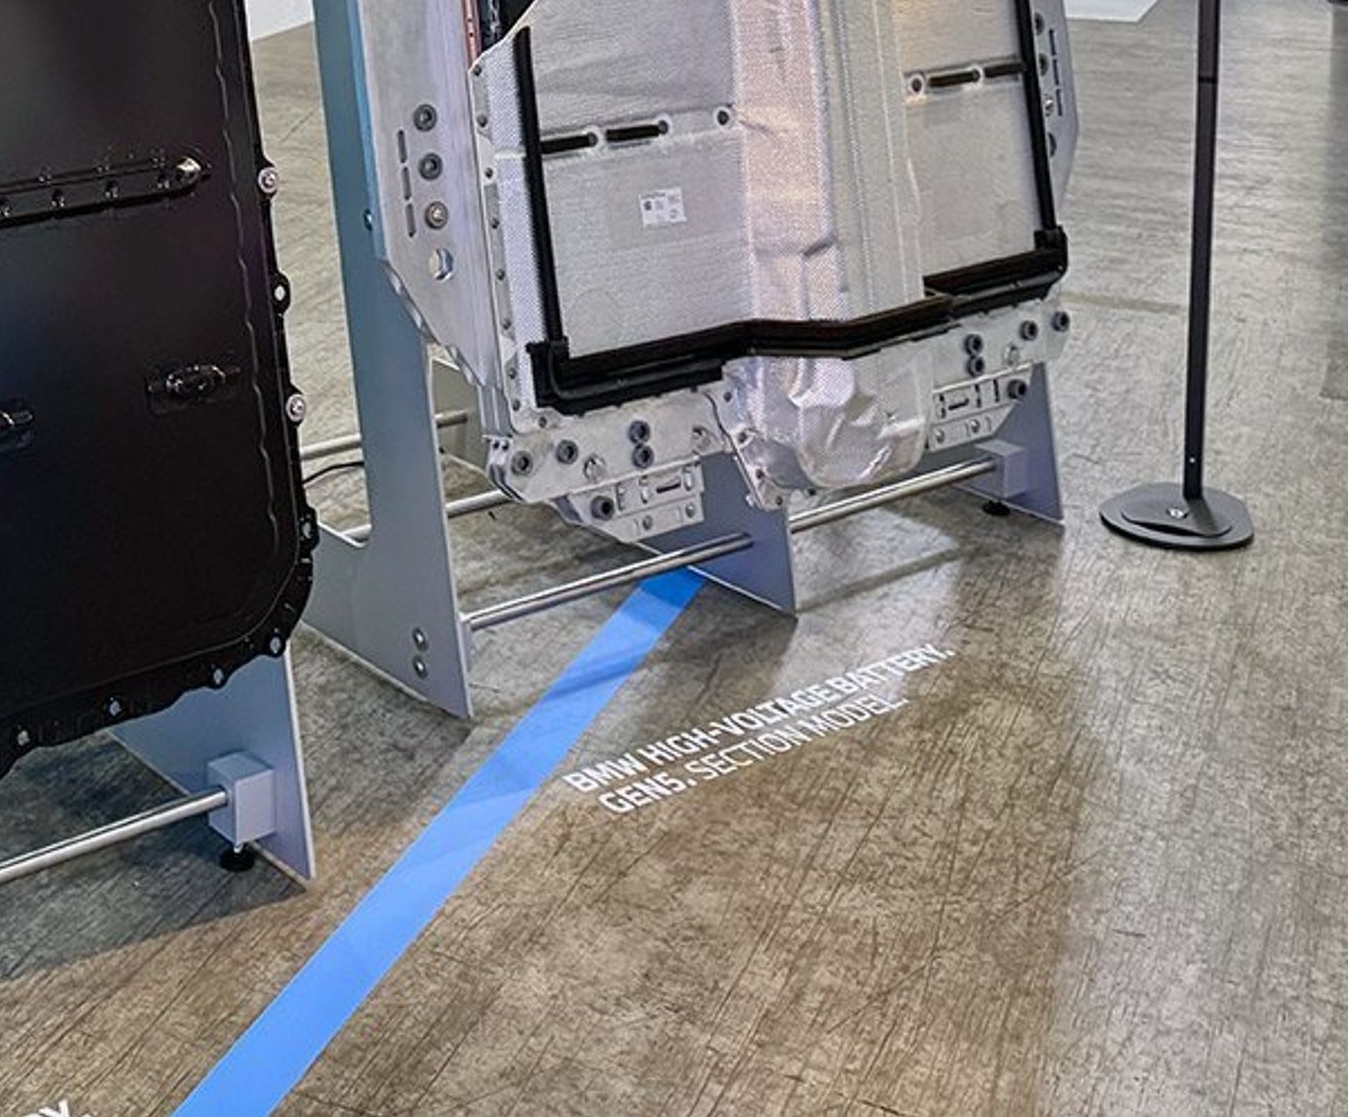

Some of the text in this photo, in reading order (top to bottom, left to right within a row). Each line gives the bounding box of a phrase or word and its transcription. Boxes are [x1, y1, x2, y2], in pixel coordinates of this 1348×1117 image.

[562, 643, 956, 793] BMW HIGH-VOLTAGE BATTERY.
[598, 694, 910, 813] GEN5. SECTION MODEL.
